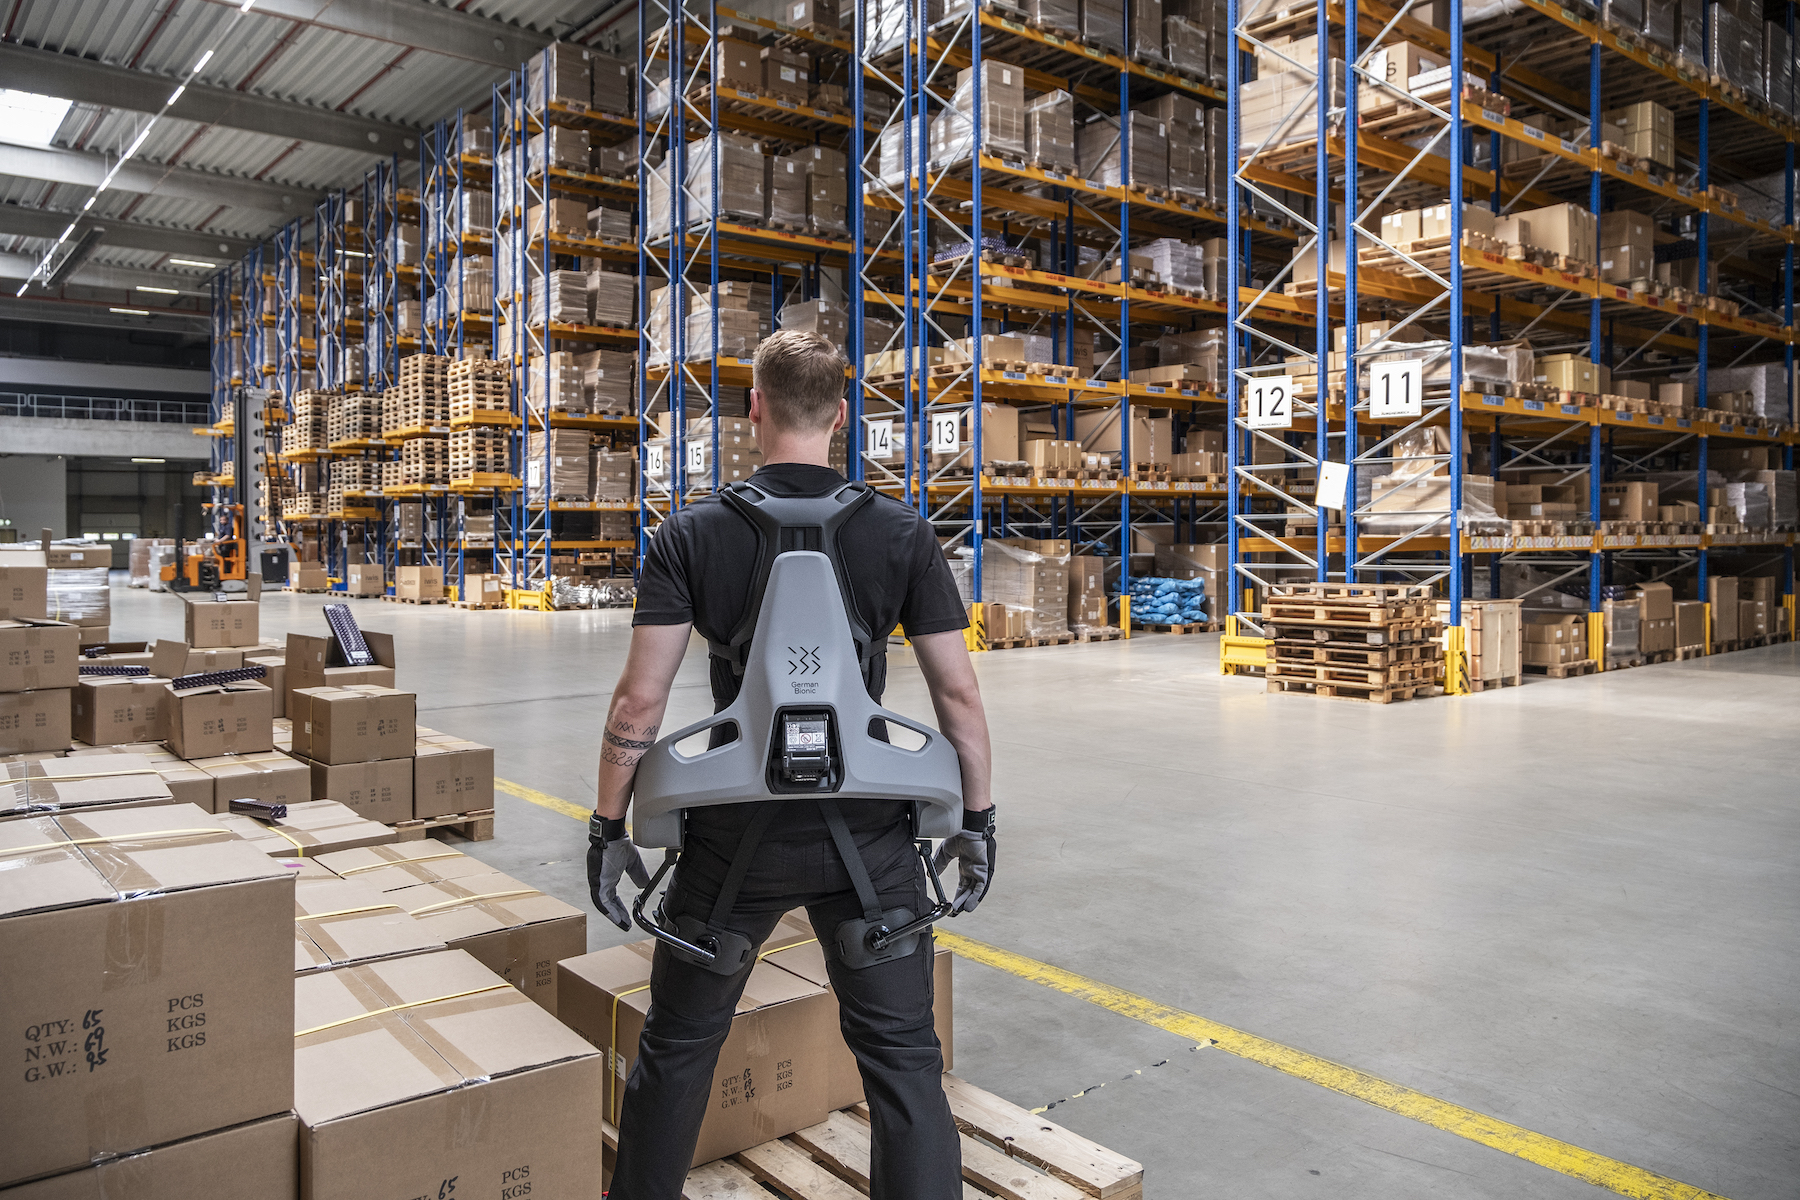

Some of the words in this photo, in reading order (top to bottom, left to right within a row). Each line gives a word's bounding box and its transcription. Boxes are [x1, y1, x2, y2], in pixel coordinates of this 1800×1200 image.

[1381, 371, 1410, 405] 11
[1255, 386, 1285, 417] 12
[871, 428, 888, 451] 14
[936, 421, 954, 445] 13
[650, 452, 661, 469] 16
[690, 447, 702, 466] 15
[529, 465, 538, 482] 17
[535, 969, 551, 978] KGS
[536, 960, 550, 969] PCS
[535, 978, 551, 987] KGS
[25, 1019, 74, 1042] QTY:
[82, 1009, 103, 1029] 65
[167, 994, 204, 1013] PCS
[25, 1040, 77, 1062] N.W.:
[166, 1012, 206, 1032] KGS
[24, 1061, 77, 1083] G.W.:
[166, 1032, 206, 1052] KGS
[721, 1075, 741, 1088] QTY:
[777, 1059, 792, 1070] PCS
[776, 1069, 793, 1081] KGS
[776, 1080, 793, 1092] KGS
[501, 1165, 530, 1184] PCS
[501, 1182, 532, 1200] KGS
